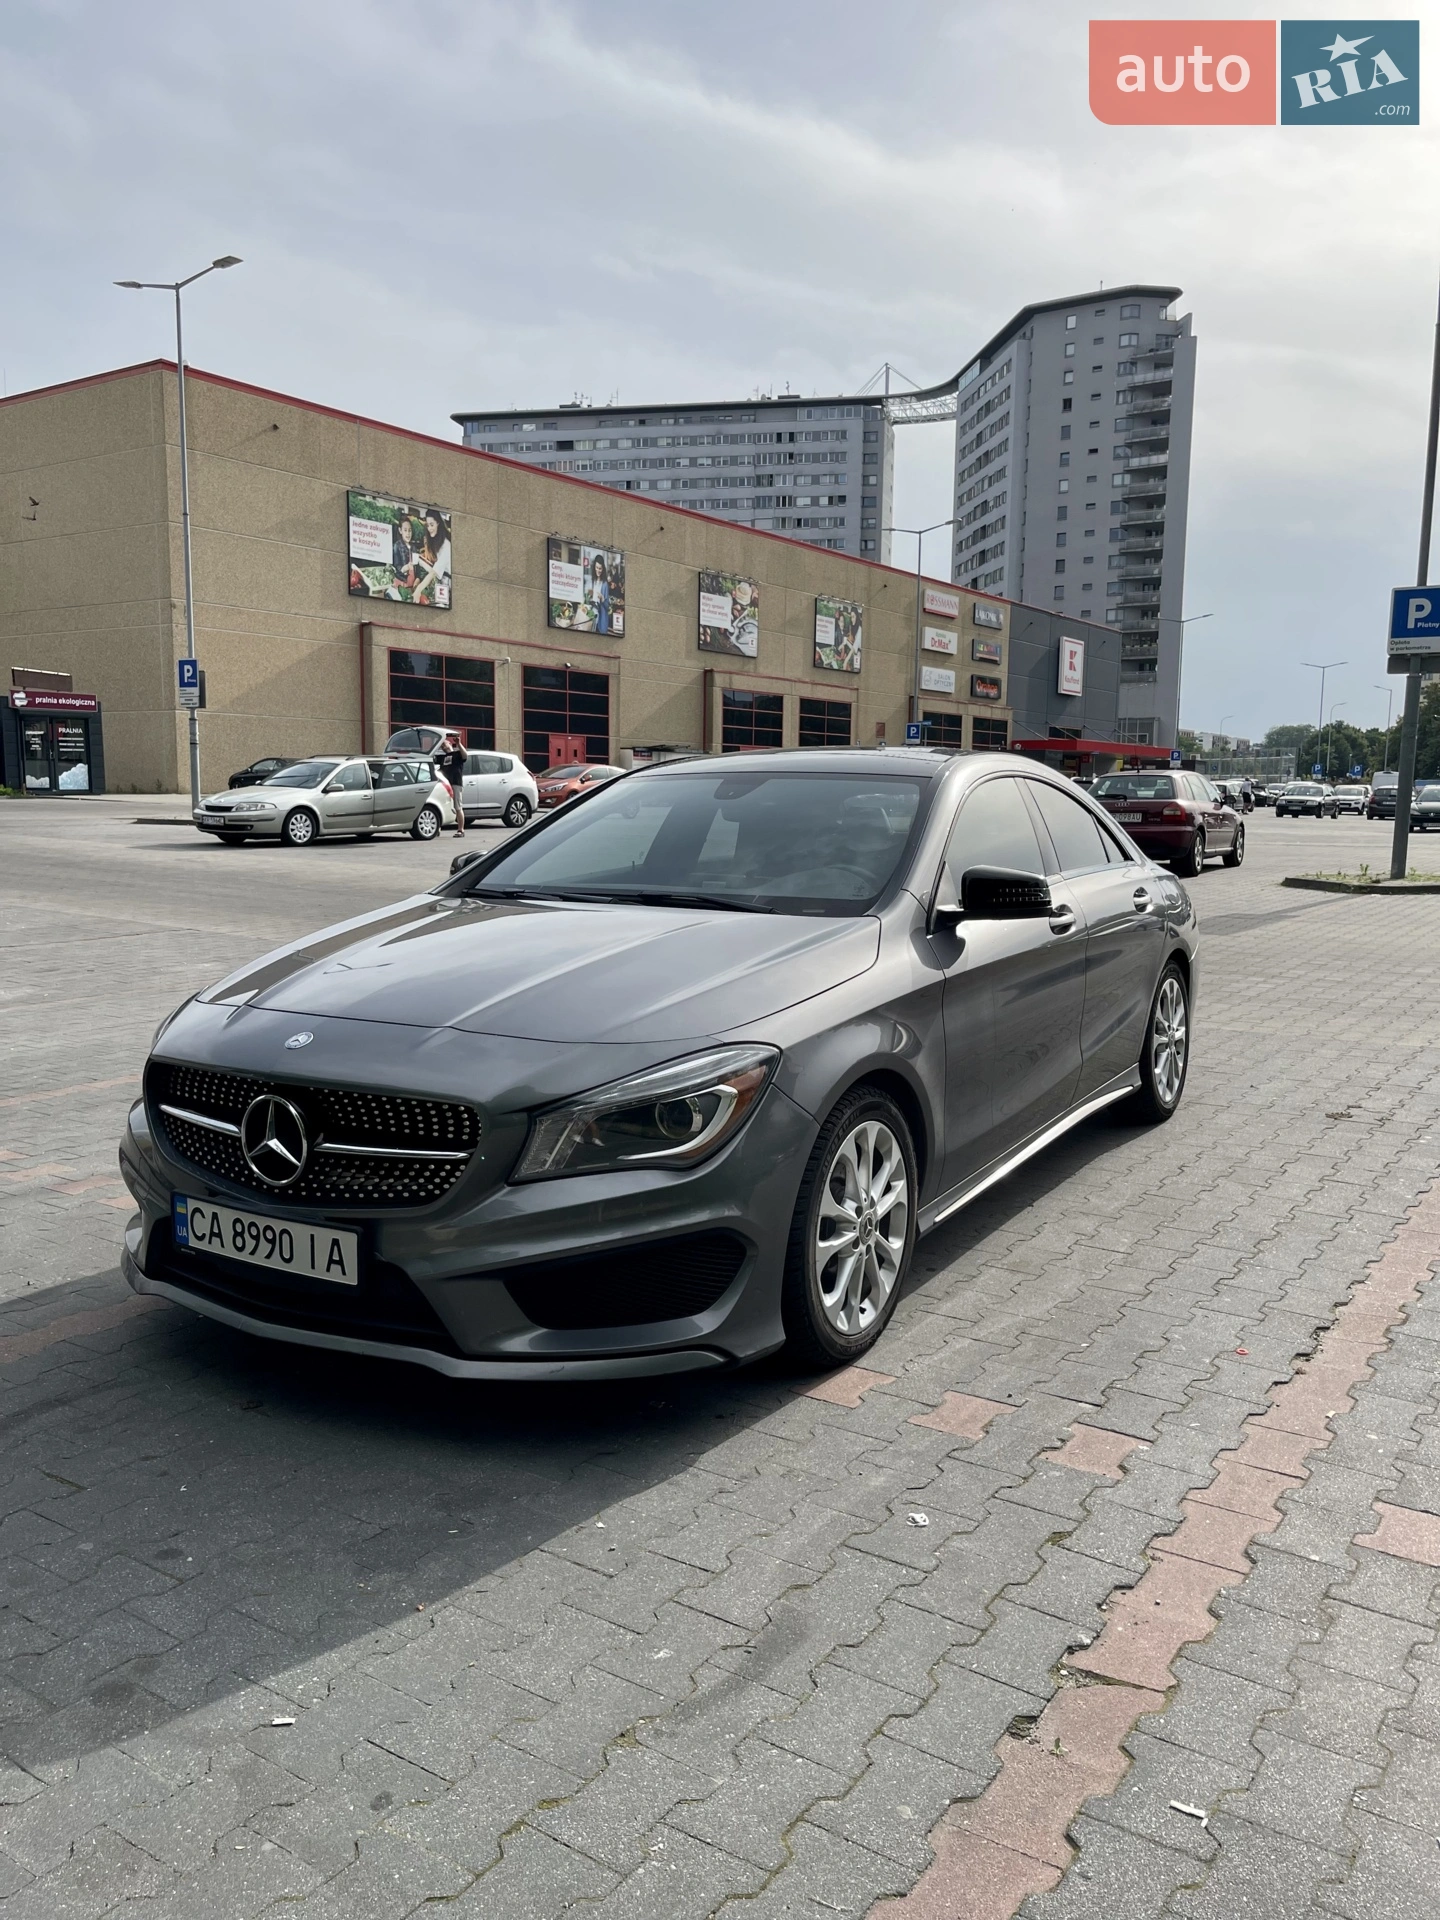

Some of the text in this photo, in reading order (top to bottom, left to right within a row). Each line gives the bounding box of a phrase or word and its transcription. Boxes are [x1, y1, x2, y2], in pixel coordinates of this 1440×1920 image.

[352, 529, 378, 539] wszystko
[358, 537, 381, 548] koszyku
[927, 594, 958, 610] ROSSMANN
[1407, 598, 1431, 629] P
[1069, 650, 1077, 672] K
[184, 664, 193, 682] P
[976, 680, 998, 696] Orange
[35, 696, 58, 704] pralnia
[58, 698, 96, 706] ekologiczna
[910, 726, 917, 736] P
[177, 1225, 188, 1238] UA
[190, 1206, 347, 1276] CA 8990 IA
